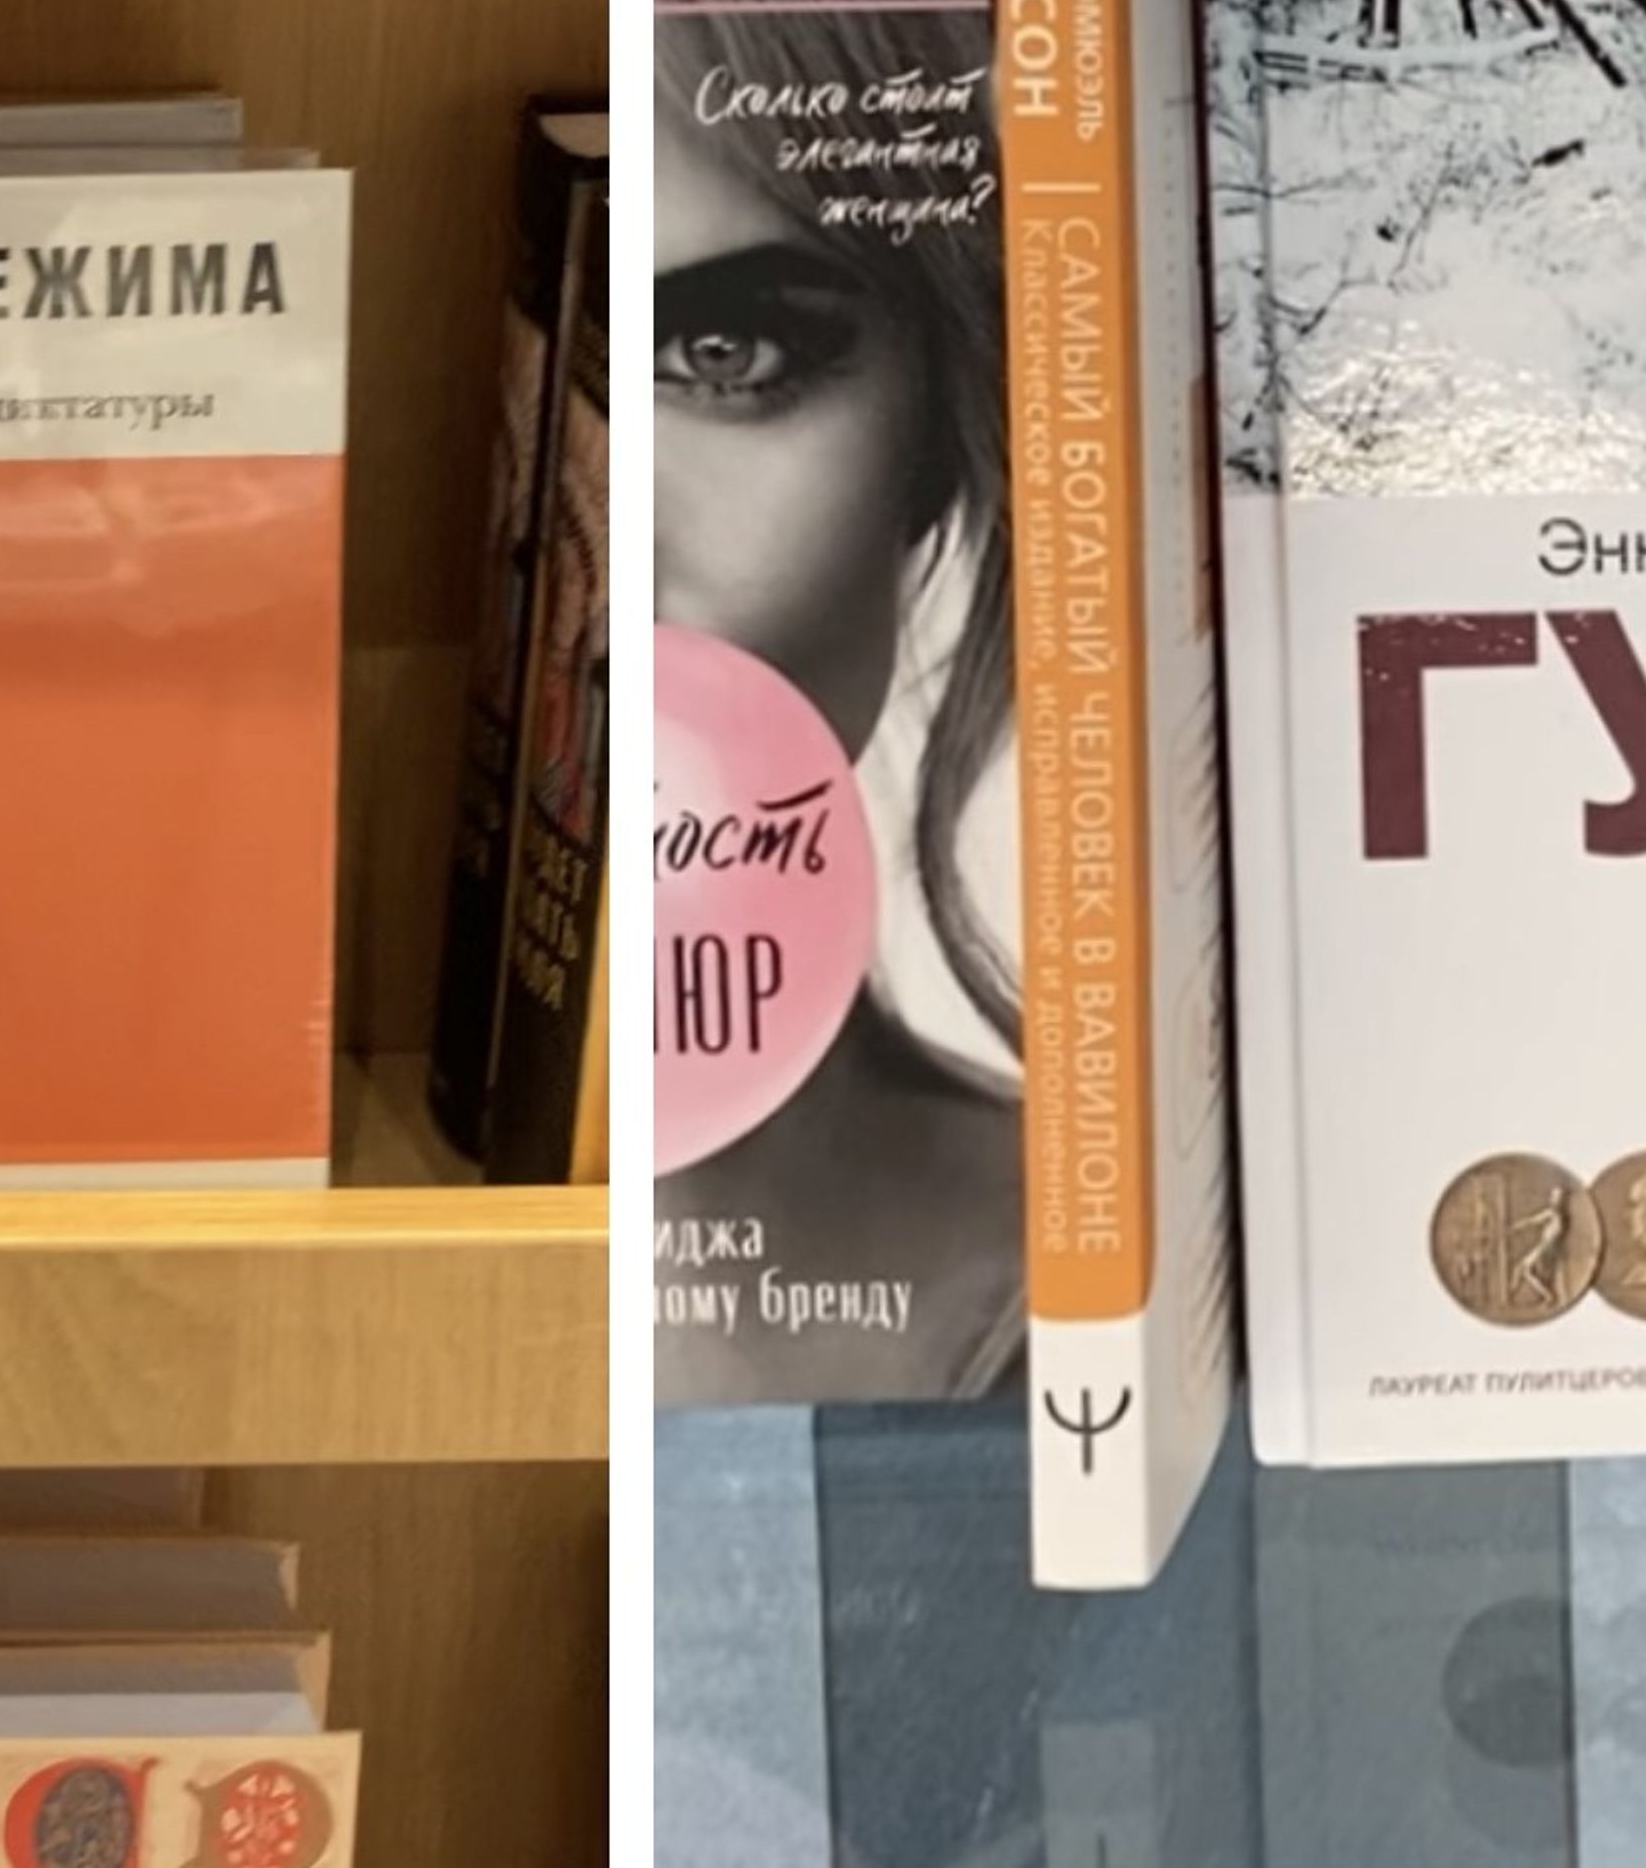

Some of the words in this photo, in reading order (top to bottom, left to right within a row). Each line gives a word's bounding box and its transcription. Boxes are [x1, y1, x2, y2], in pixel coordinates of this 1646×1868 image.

[695, 64, 849, 126] Сколько
[858, 66, 989, 120] стоит
[776, 121, 982, 173] элегантная
[1019, 218, 1058, 486] Классическое
[1058, 215, 1112, 422] САМЫЙ
[1024, 496, 1061, 670] издание,
[1064, 438, 1118, 675] БОГАТЫЙ
[1031, 682, 1068, 955] исправленное
[1067, 690, 1116, 918] ЧЕЛОВЕК
[1073, 935, 1113, 966] В
[1036, 998, 1070, 1253] дополненное
[1074, 980, 1122, 1253] ВАВИЛОНЕ
[760, 1265, 914, 1332] бренду
[1368, 1371, 1478, 1399] ЛАУРЕАТ
